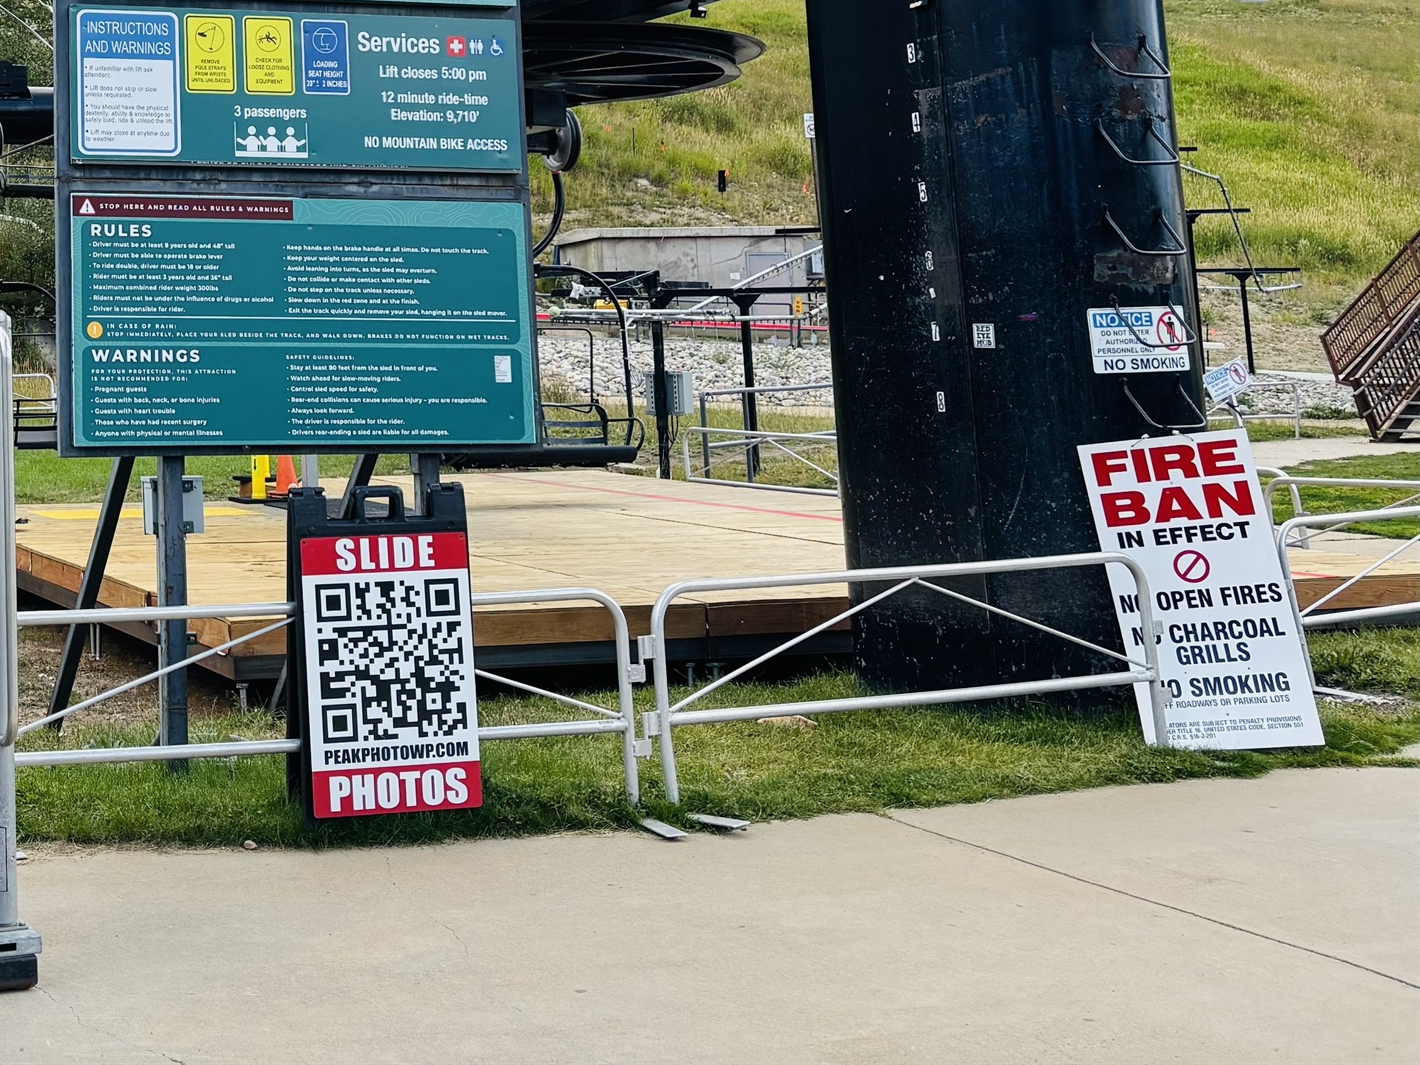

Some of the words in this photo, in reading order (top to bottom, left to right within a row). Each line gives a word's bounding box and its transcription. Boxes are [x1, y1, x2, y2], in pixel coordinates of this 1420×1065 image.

[87, 20, 168, 36] INSTRUCTIONS
[84, 39, 108, 53] AND
[110, 40, 171, 55] WARNINGS
[357, 31, 440, 54] Services
[312, 60, 337, 68] LOADING
[307, 69, 322, 77] SEAT
[322, 70, 343, 78] HEIGHT
[379, 64, 399, 78] Lift
[401, 65, 438, 79] closes
[441, 66, 466, 80] 5:00
[468, 70, 486, 82] pm
[380, 90, 394, 102] 12
[397, 91, 435, 104] minute
[438, 92, 488, 105] ride-time
[233, 104, 241, 116] 3
[243, 107, 306, 120] passengers
[390, 108, 443, 121] Elevation:
[445, 109, 479, 124] 9,710'
[364, 136, 379, 148] NO
[382, 136, 437, 149] MOUNTAIN
[439, 137, 464, 149] BIKE
[466, 138, 507, 150] ACCESS
[90, 223, 151, 237] RULES
[91, 348, 200, 362] WARNINGS
[1103, 358, 1126, 371] NO
[1130, 356, 1185, 370] SMOKING
[1205, 368, 1229, 385] NOTICE
[1091, 439, 1245, 487] FIRE
[1100, 480, 1256, 528] BAN
[1117, 531, 1145, 549] IN
[1154, 521, 1250, 546] EFFECT
[335, 535, 435, 571] SLIDE
[1156, 588, 1214, 611] OPEN
[1222, 582, 1282, 606] FIRES
[1168, 617, 1286, 644] CHARCOAL
[1176, 641, 1251, 666] GRILLS
[1189, 672, 1291, 698] SMOKING
[1175, 698, 1218, 708] ROADWAYS
[1219, 697, 1231, 706] OR
[1233, 695, 1268, 705] PARKING
[1269, 694, 1290, 703] LOTS
[324, 740, 468, 765] PEAKPHOTOWP.COM
[328, 767, 468, 812] PHOTOS
